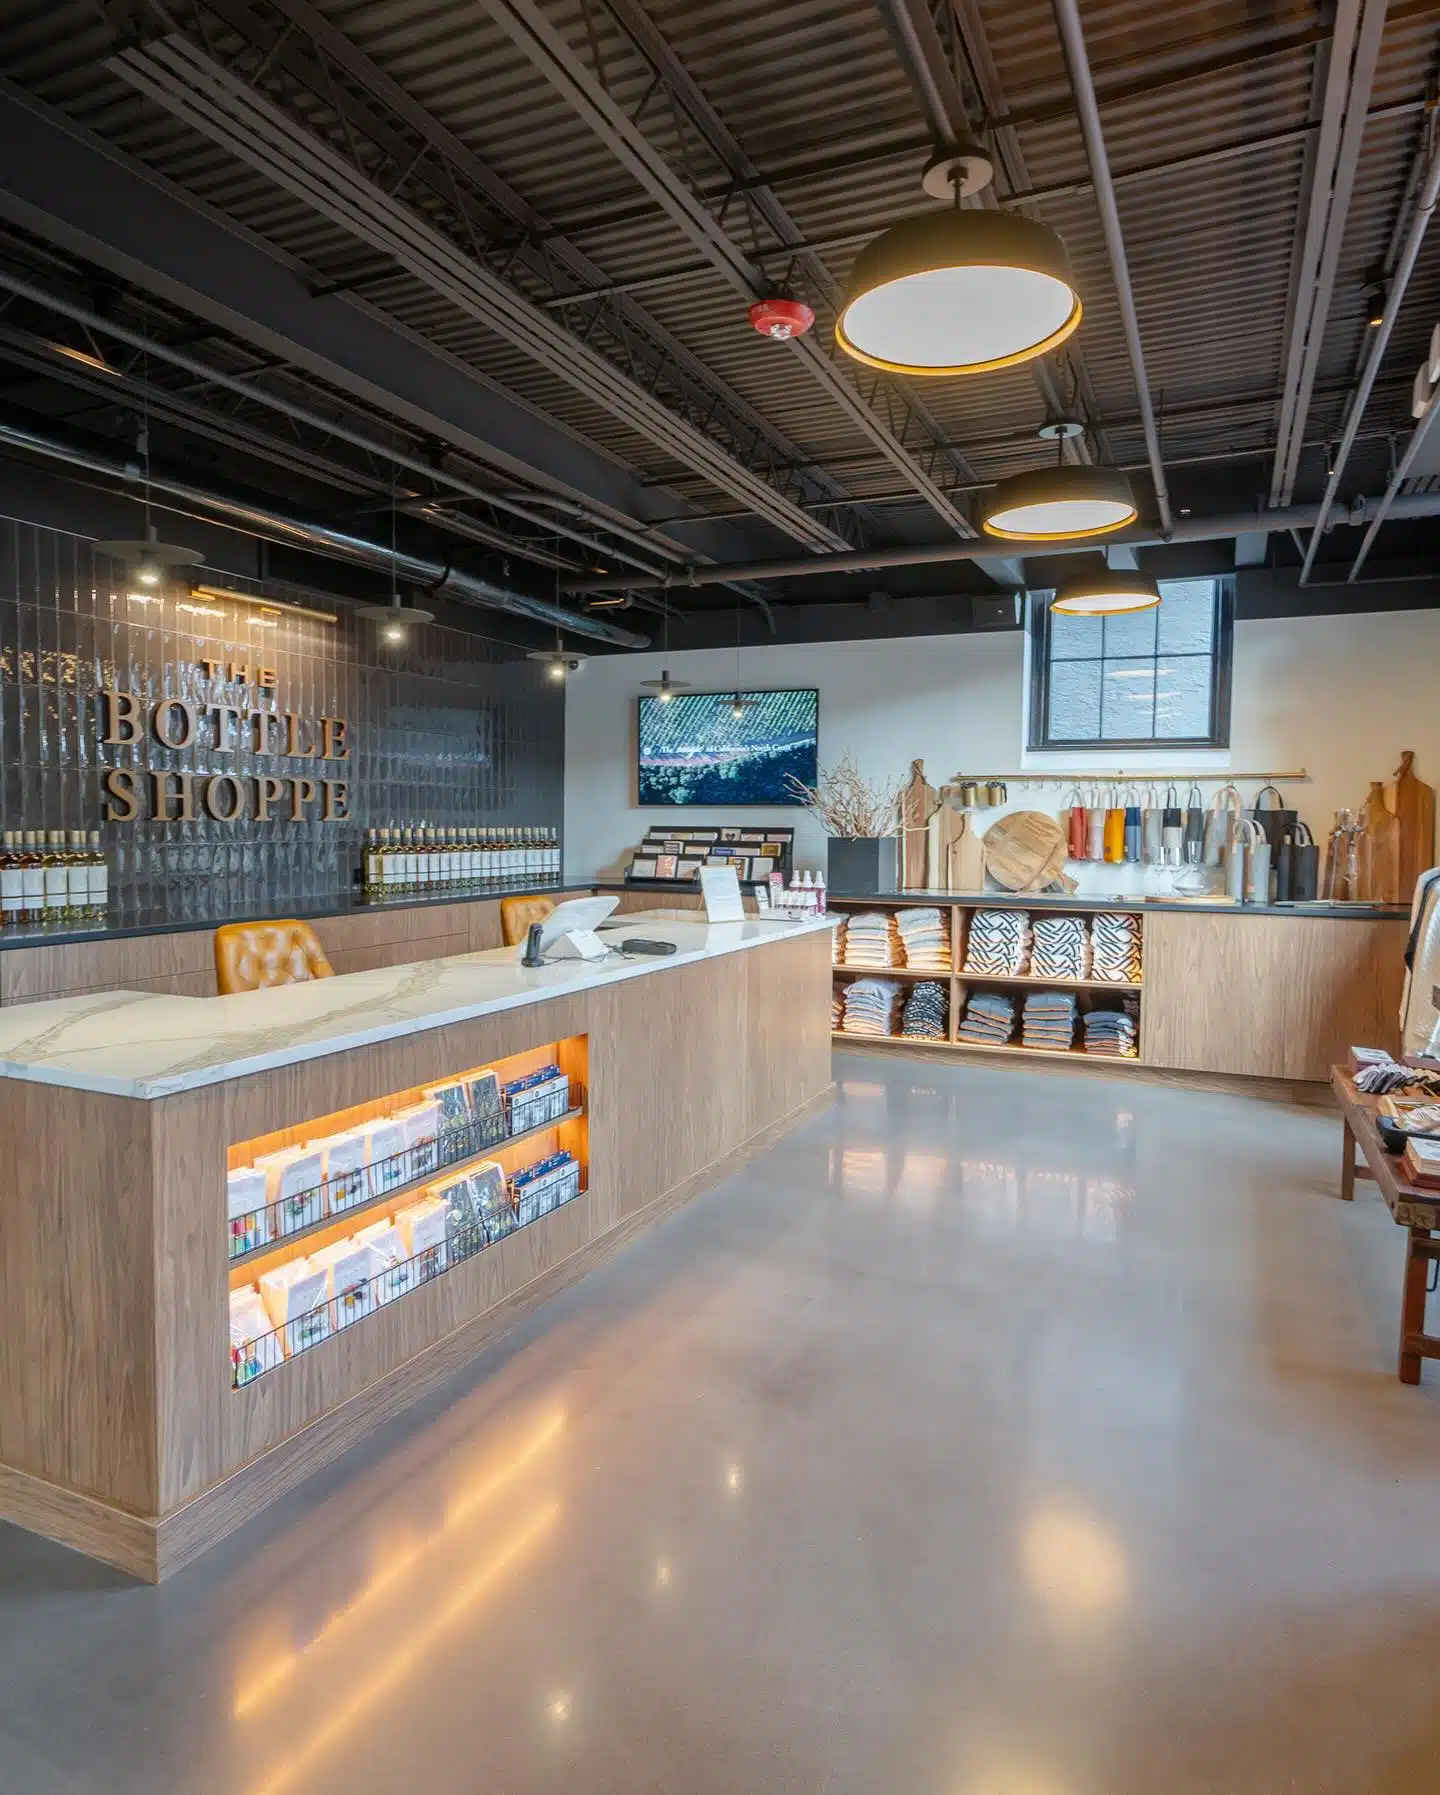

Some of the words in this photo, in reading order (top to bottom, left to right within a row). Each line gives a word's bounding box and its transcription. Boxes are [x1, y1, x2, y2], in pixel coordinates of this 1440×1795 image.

[200, 658, 277, 688] THE
[102, 690, 350, 761] BOTTLE
[752, 743, 771, 752] North
[106, 767, 350, 822] SHOPPE
